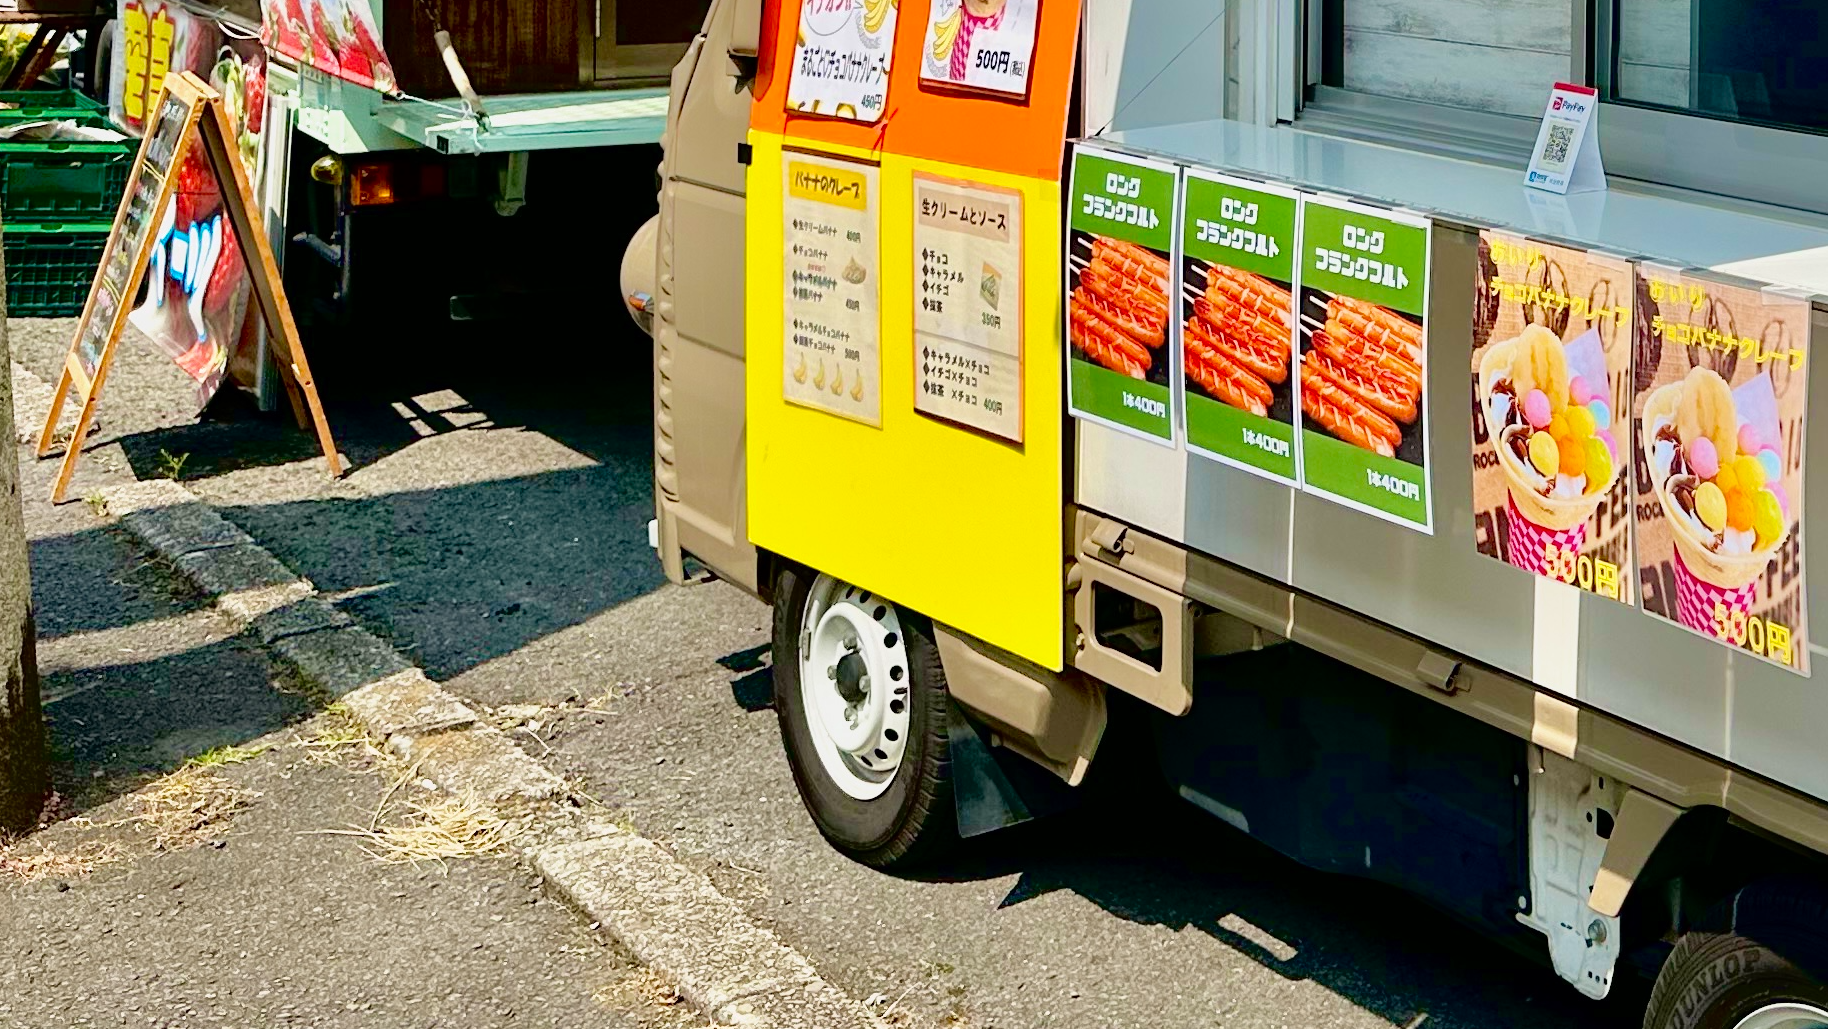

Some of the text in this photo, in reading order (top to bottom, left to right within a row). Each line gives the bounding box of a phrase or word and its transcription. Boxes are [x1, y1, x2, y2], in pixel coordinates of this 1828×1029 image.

[975, 49, 1010, 73] 500円
[861, 94, 882, 111] 450円
[1562, 100, 1586, 113] PayPay
[1105, 172, 1141, 198] ロング
[922, 198, 1007, 232] 生クリームとソース
[1082, 193, 1160, 230] フランクフルト
[1220, 197, 1259, 226] ロング
[1196, 219, 1280, 258] フランクフルト
[1342, 224, 1385, 254] ロング
[929, 251, 949, 265] チョコ
[1315, 247, 1409, 290] フランクフルト
[1489, 238, 1544, 273] おいり
[929, 267, 964, 284] キャラメル
[929, 283, 949, 297] イチゴ
[1490, 276, 1630, 330] チョコバナナクレープ
[1649, 279, 1707, 312] おいり
[1651, 314, 1804, 372] チョコバナナクレープ
[1122, 390, 1166, 419] 1本400円
[1241, 427, 1290, 458] 1本400円
[1366, 467, 1420, 502] 1本400円
[1544, 543, 1619, 601] 500円
[1714, 601, 1793, 666] 500円
